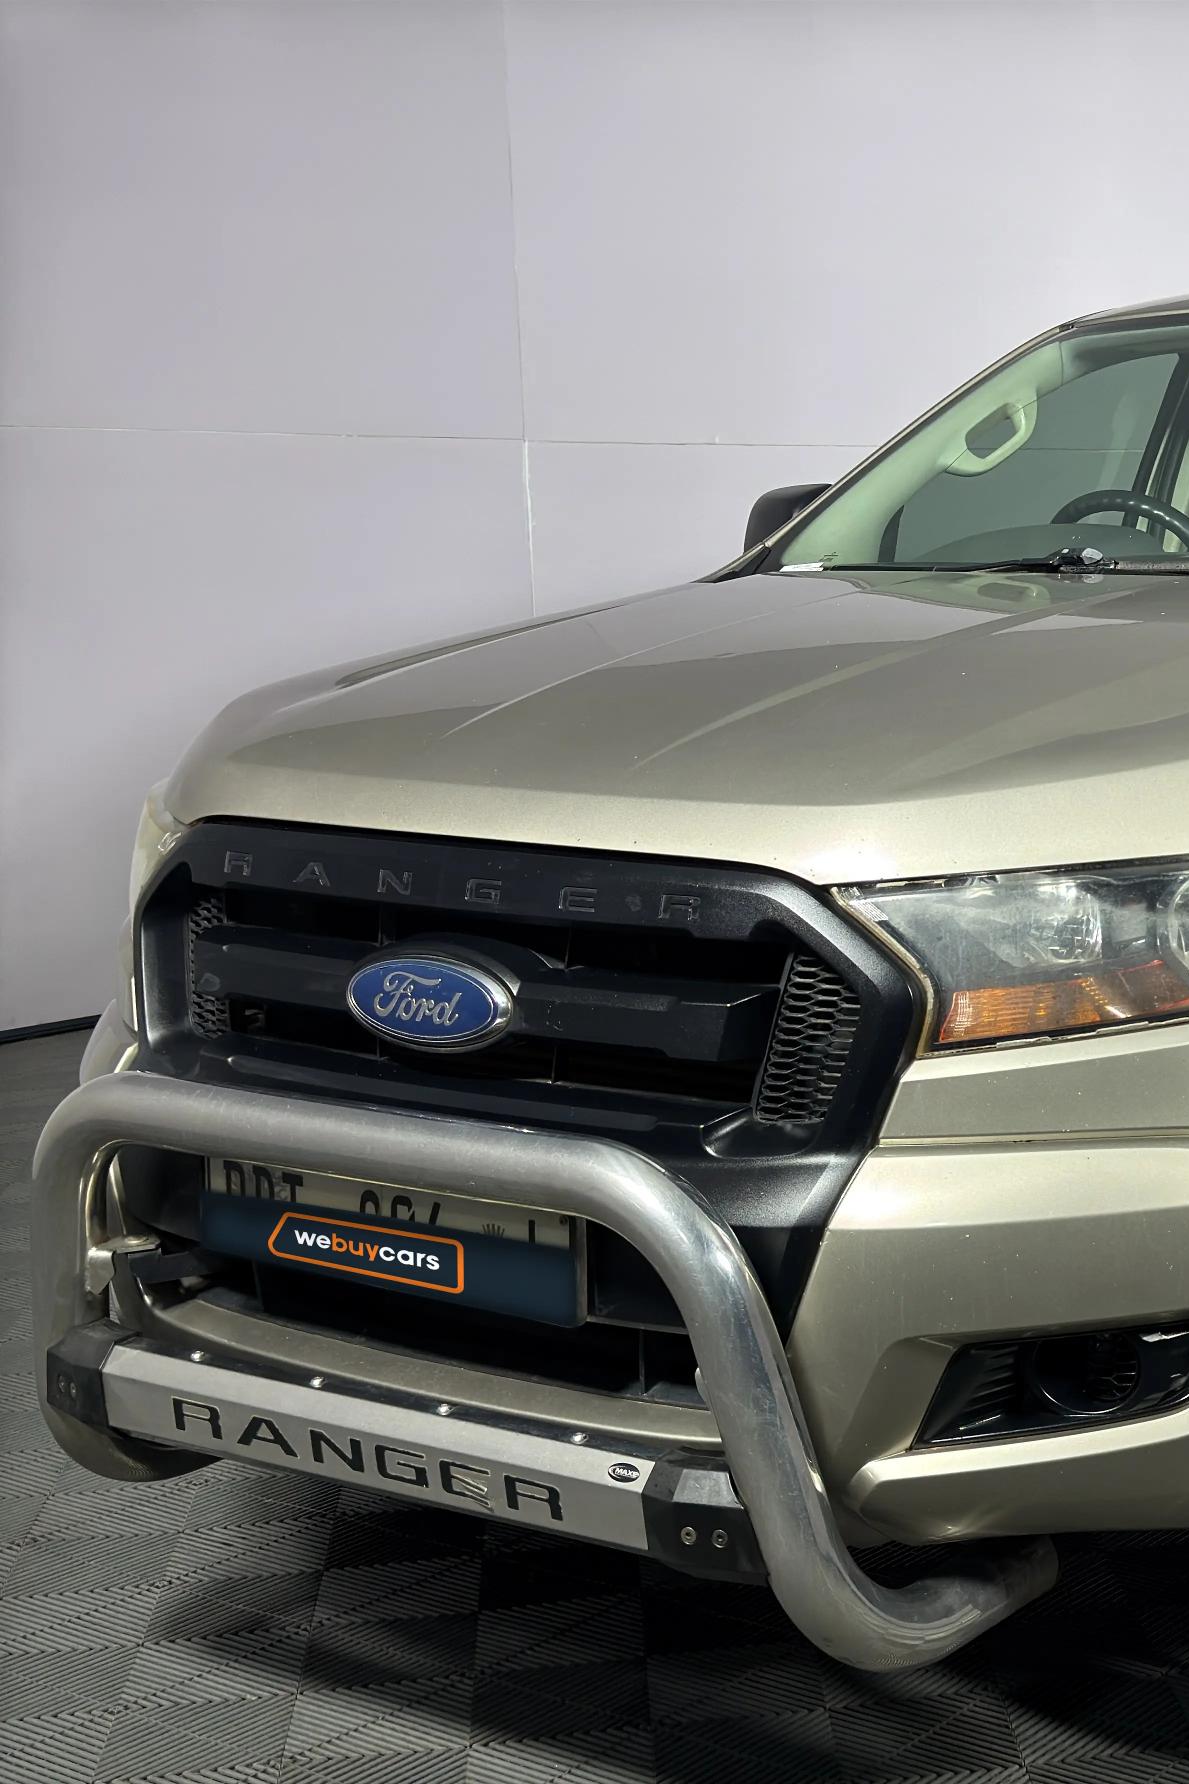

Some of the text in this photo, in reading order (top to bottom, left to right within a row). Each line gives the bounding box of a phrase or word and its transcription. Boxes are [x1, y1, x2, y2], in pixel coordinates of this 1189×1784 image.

[224, 850, 700, 921] RANGER
[374, 971, 462, 1026] Ford
[172, 1397, 564, 1521] RANGER
